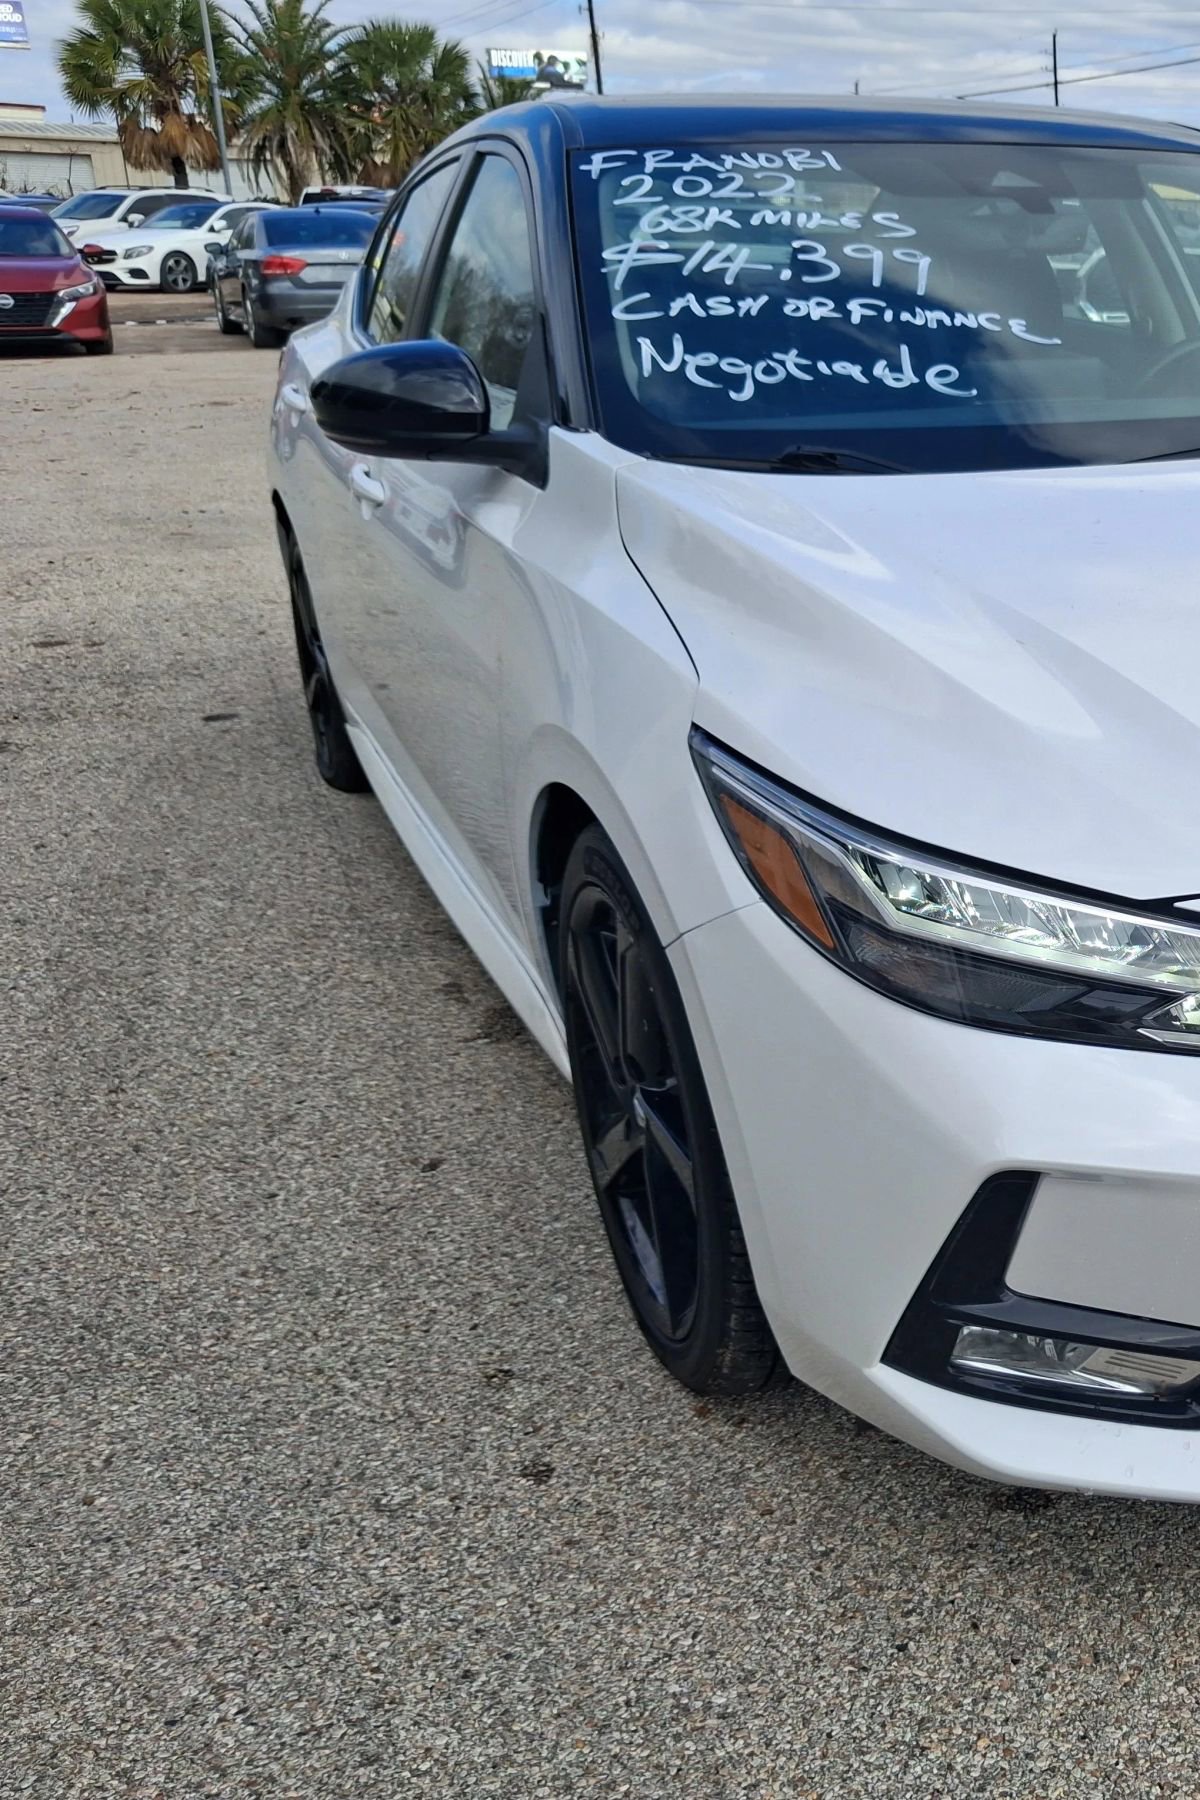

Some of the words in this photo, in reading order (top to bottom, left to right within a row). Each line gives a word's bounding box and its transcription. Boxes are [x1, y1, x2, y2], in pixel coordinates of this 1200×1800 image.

[613, 173, 822, 205] 2022
[639, 204, 741, 233] 68K
[750, 209, 916, 238] MILES
[612, 292, 769, 320] CASH
[783, 297, 842, 320] OR
[847, 298, 1062, 344] FINANCE
